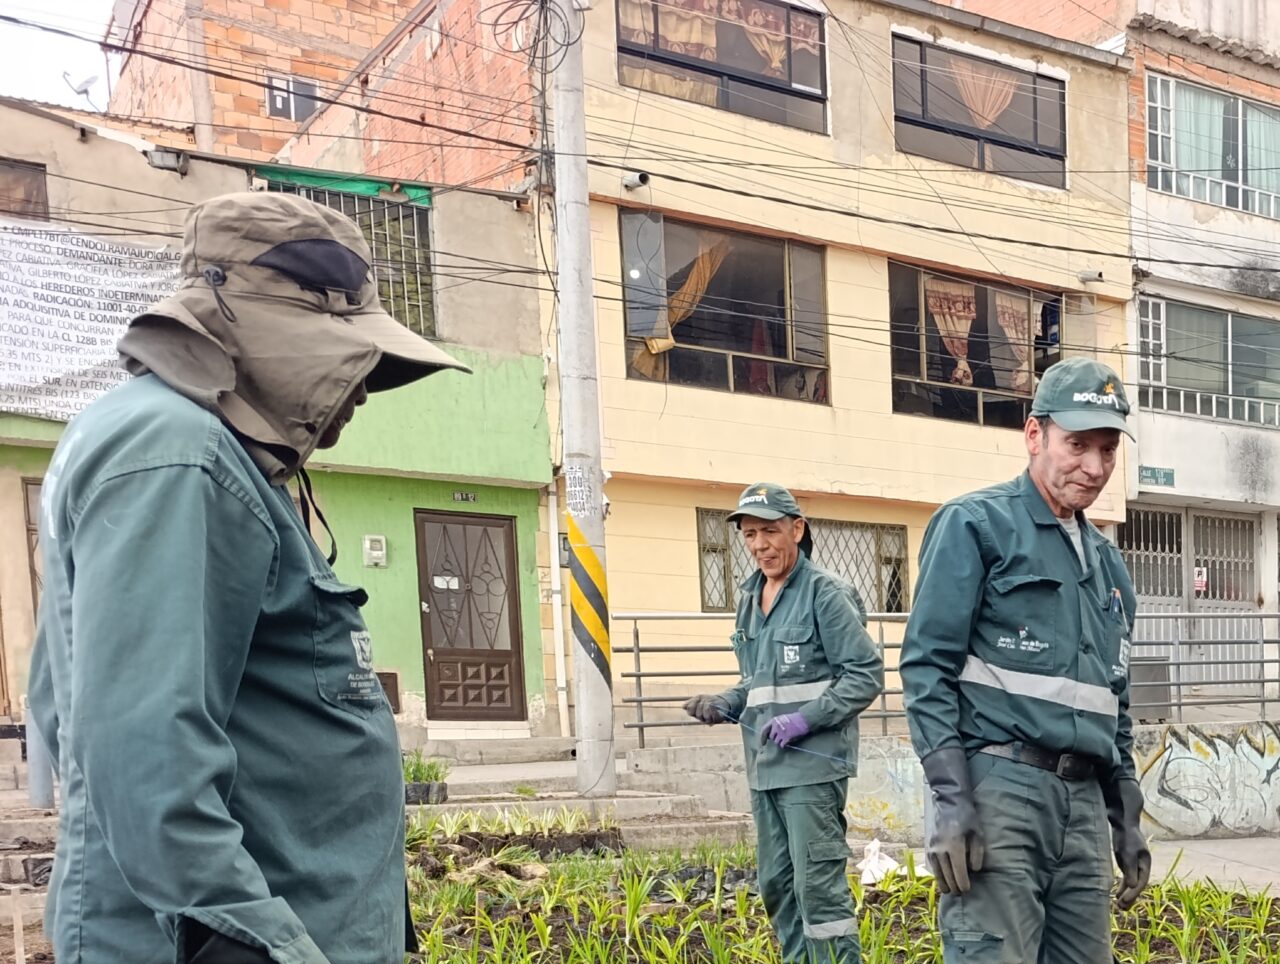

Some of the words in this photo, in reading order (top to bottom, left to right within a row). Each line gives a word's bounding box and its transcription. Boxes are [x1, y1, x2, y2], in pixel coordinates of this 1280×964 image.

[41, 281, 95, 297] HEREDEROS
[13, 299, 70, 318] ADQUISITIVA
[74, 310, 86, 321] DE
[8, 310, 32, 324] PARA
[35, 315, 53, 327] QUE
[32, 327, 44, 338] EN
[48, 330, 59, 340] LA
[61, 332, 72, 342] CL
[76, 334, 97, 346] 128B
[21, 352, 41, 363] MTS
[78, 368, 91, 378] DE
[93, 369, 107, 379] SEIS
[65, 379, 77, 388] EN
[46, 387, 58, 397] BIS
